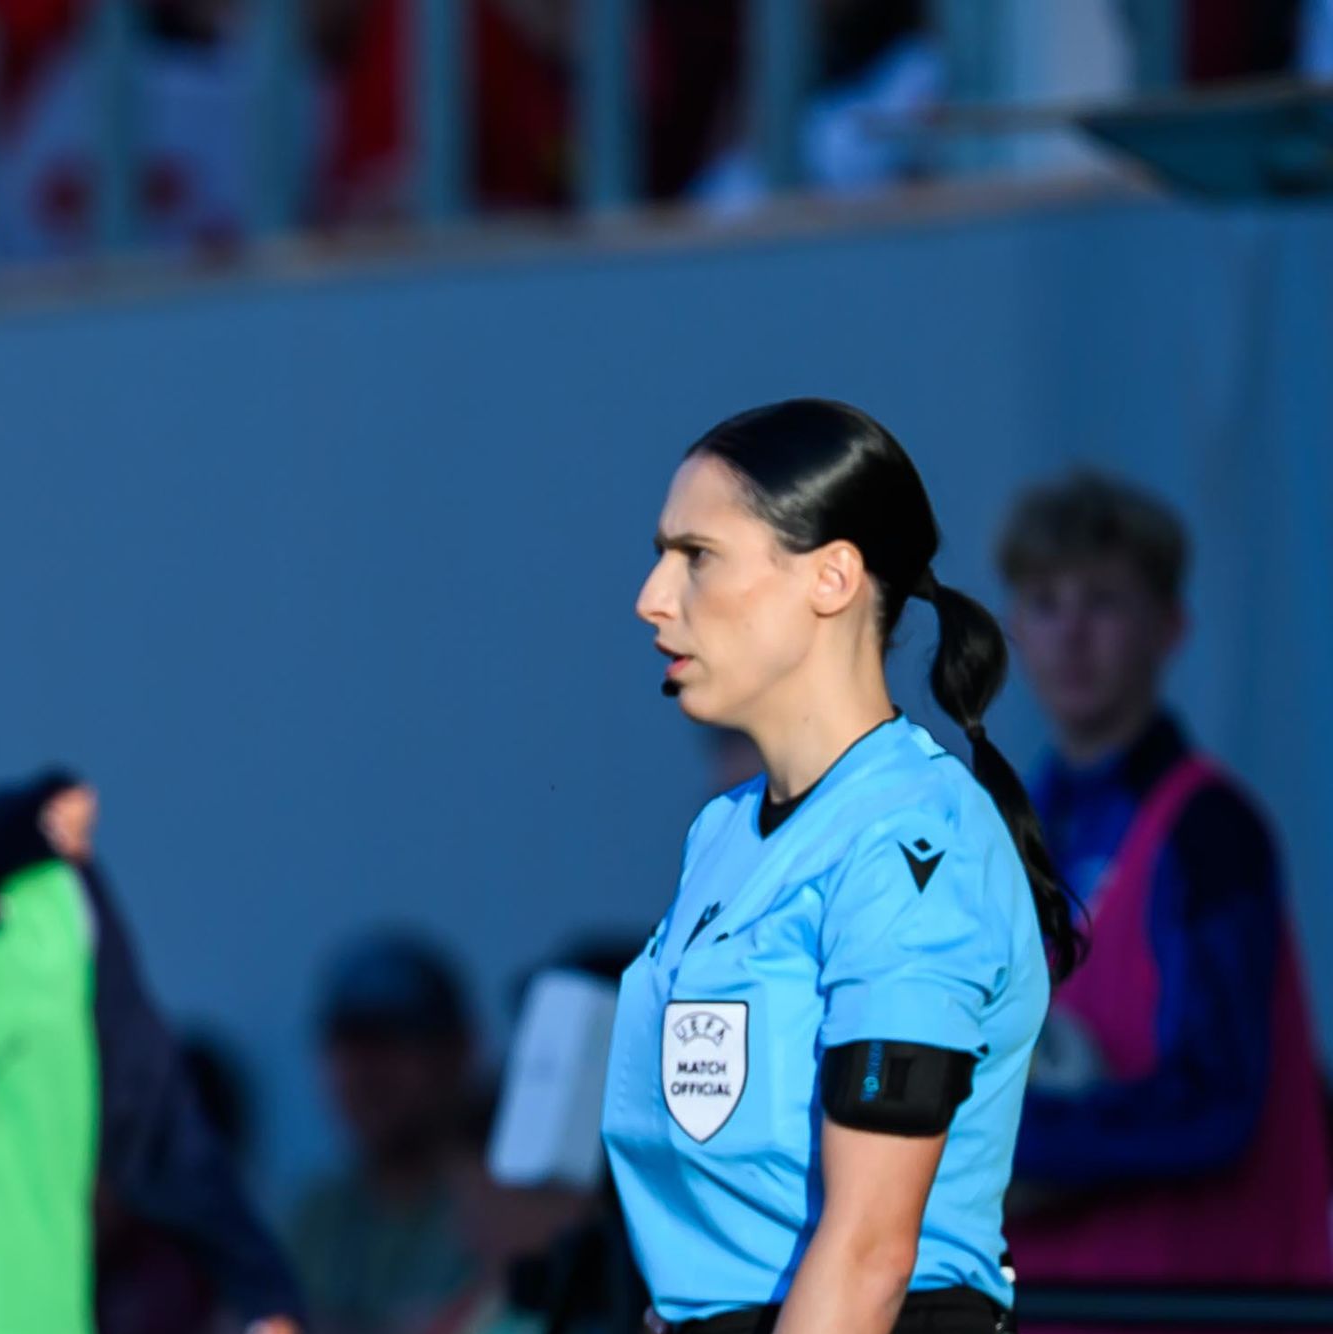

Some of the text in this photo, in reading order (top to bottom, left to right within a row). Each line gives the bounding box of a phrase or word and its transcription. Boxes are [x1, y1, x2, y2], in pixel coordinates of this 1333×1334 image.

[673, 1013, 730, 1047] UEFA
[676, 1060, 727, 1076] MATCH
[670, 1080, 732, 1097] OFFICIAL
